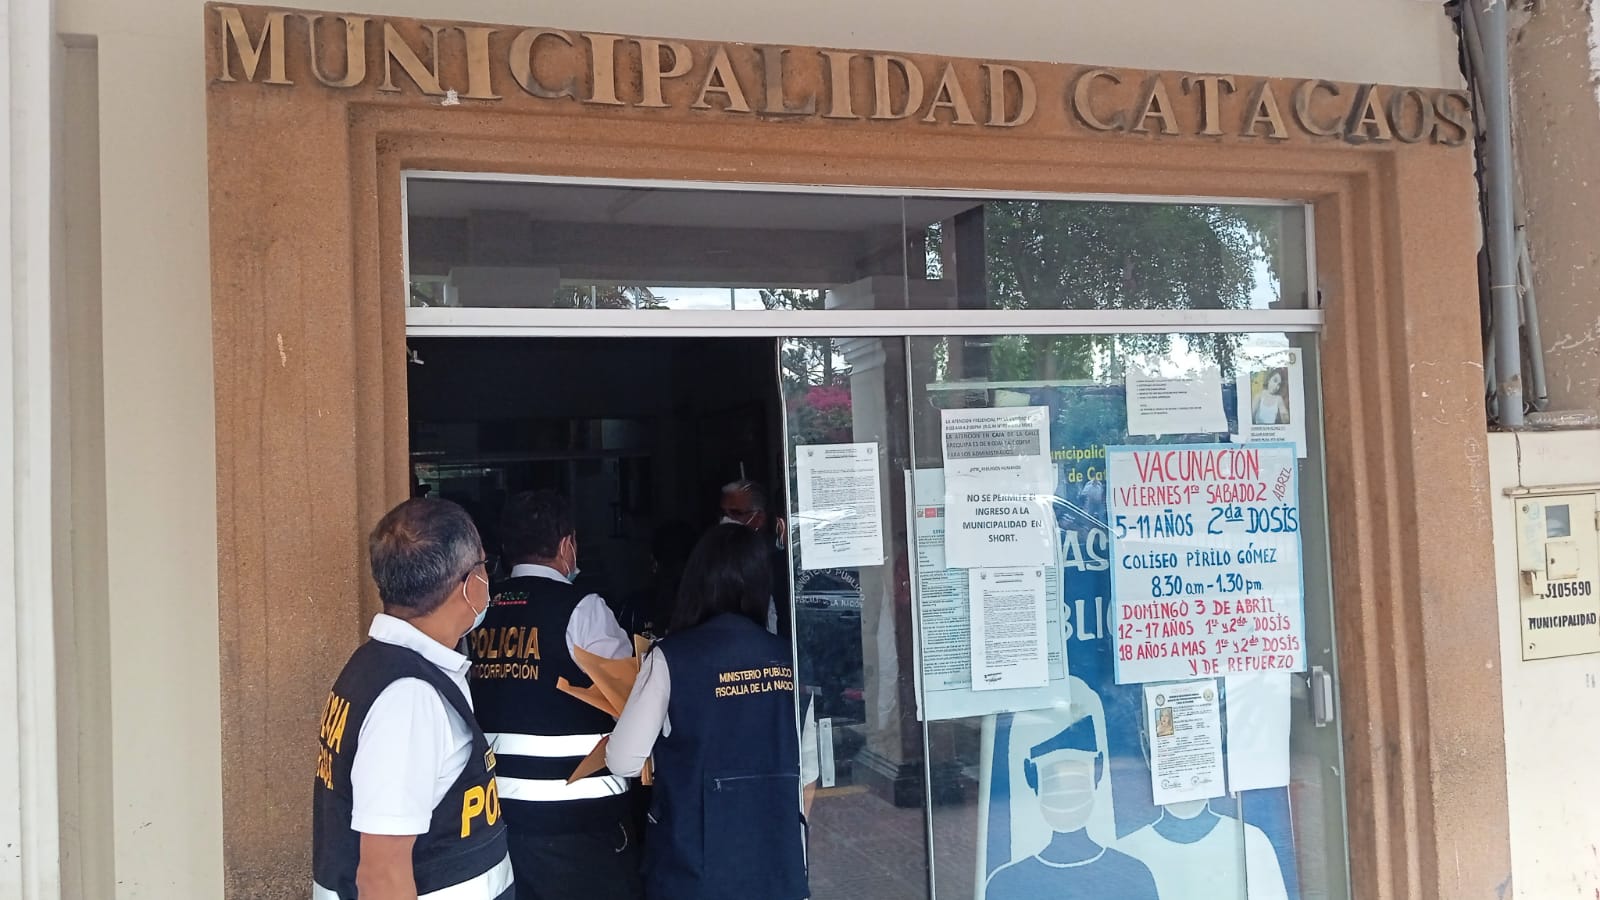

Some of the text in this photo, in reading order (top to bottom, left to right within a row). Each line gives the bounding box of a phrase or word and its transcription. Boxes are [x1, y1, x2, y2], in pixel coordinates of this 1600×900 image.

[214, 5, 1473, 146] MUNICIPALIDAD CATACAOS
[1133, 444, 1260, 483] VACUNACIÓN
[1068, 467, 1084, 482] de
[1272, 466, 1292, 502] ABRIL
[967, 494, 980, 502] NO
[982, 494, 991, 502] SE
[976, 507, 1010, 516] INGRESO
[962, 520, 1042, 530] MUNICIPALIDAD EN
[1154, 509, 1194, 538] AÑOS
[988, 534, 1018, 542] SHORT.
[1122, 543, 1277, 570] COLISEO PIRILO GÓMEZ
[1185, 582, 1204, 594] am
[1216, 573, 1244, 592] 1.30
[1122, 596, 1275, 620] DOMINGO 3 DE ABRIL
[1162, 618, 1194, 638] AÑOS
[1528, 612, 1597, 630] MUNICIPALIDAD
[1119, 644, 1133, 661] 18
[1136, 641, 1168, 660] AÑOS
[1202, 658, 1219, 674] DE
[1228, 654, 1294, 672] REFUERZO
[719, 670, 762, 683] MINISTERIO
[716, 684, 750, 698] FISCALIA
[750, 684, 760, 694] DE
[762, 682, 772, 692] LA
[461, 778, 501, 838] PO
